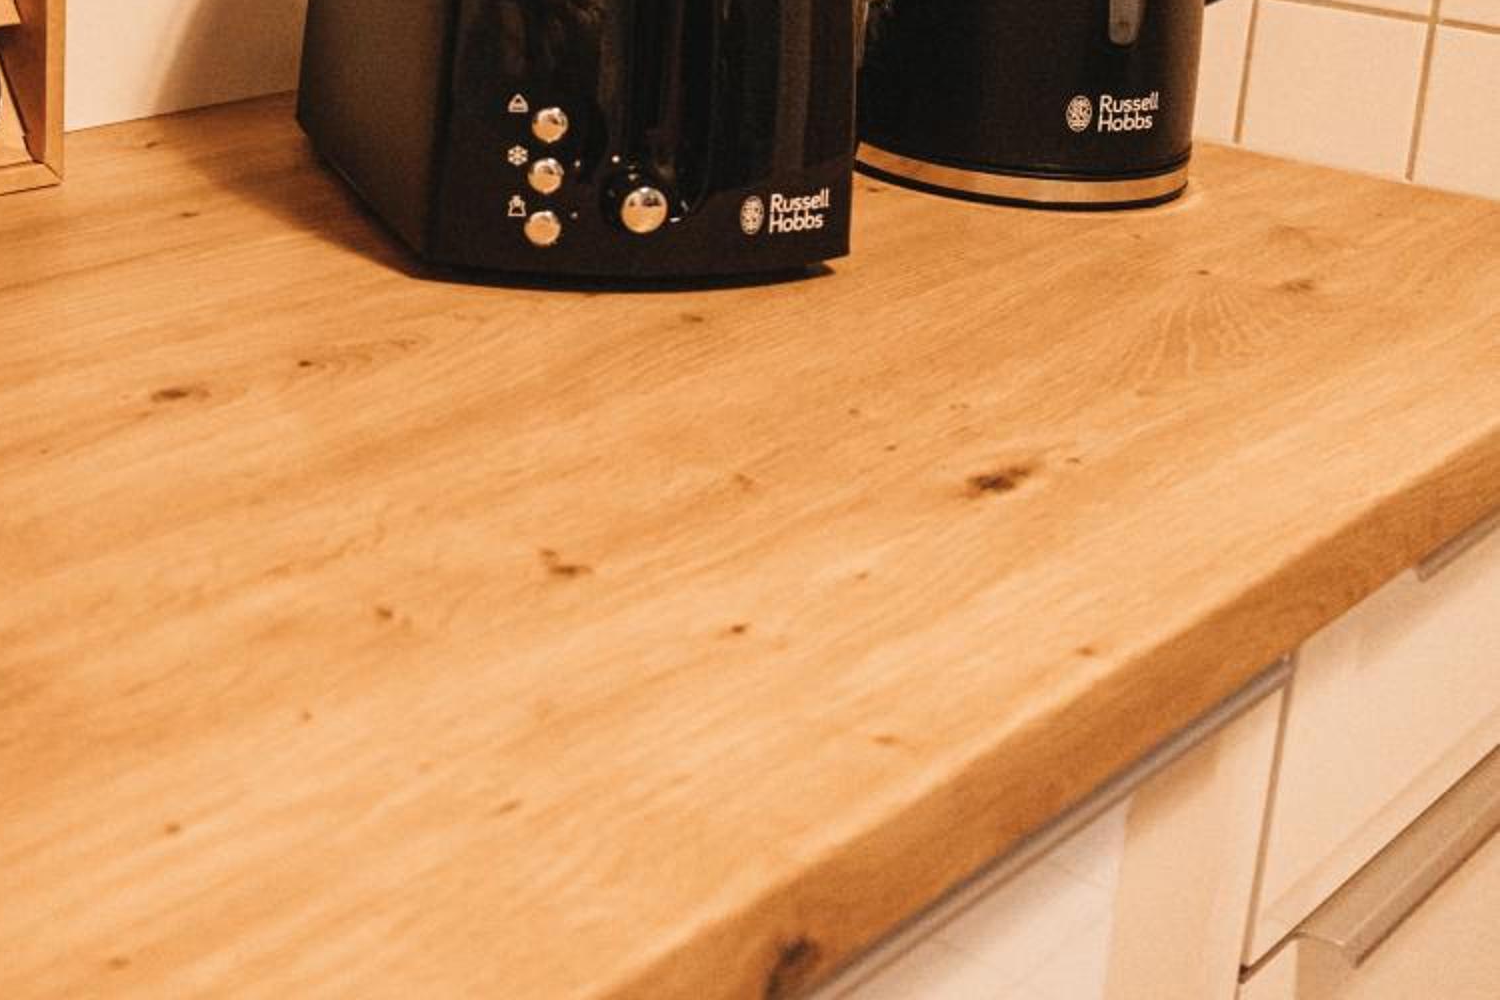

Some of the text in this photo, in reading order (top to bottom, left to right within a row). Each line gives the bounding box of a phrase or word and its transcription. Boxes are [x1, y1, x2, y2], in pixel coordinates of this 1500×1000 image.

[1100, 91, 1159, 113] Russell
[1097, 111, 1153, 133] Hobbs
[771, 188, 830, 213] Russell
[768, 210, 824, 234] Hobbs
